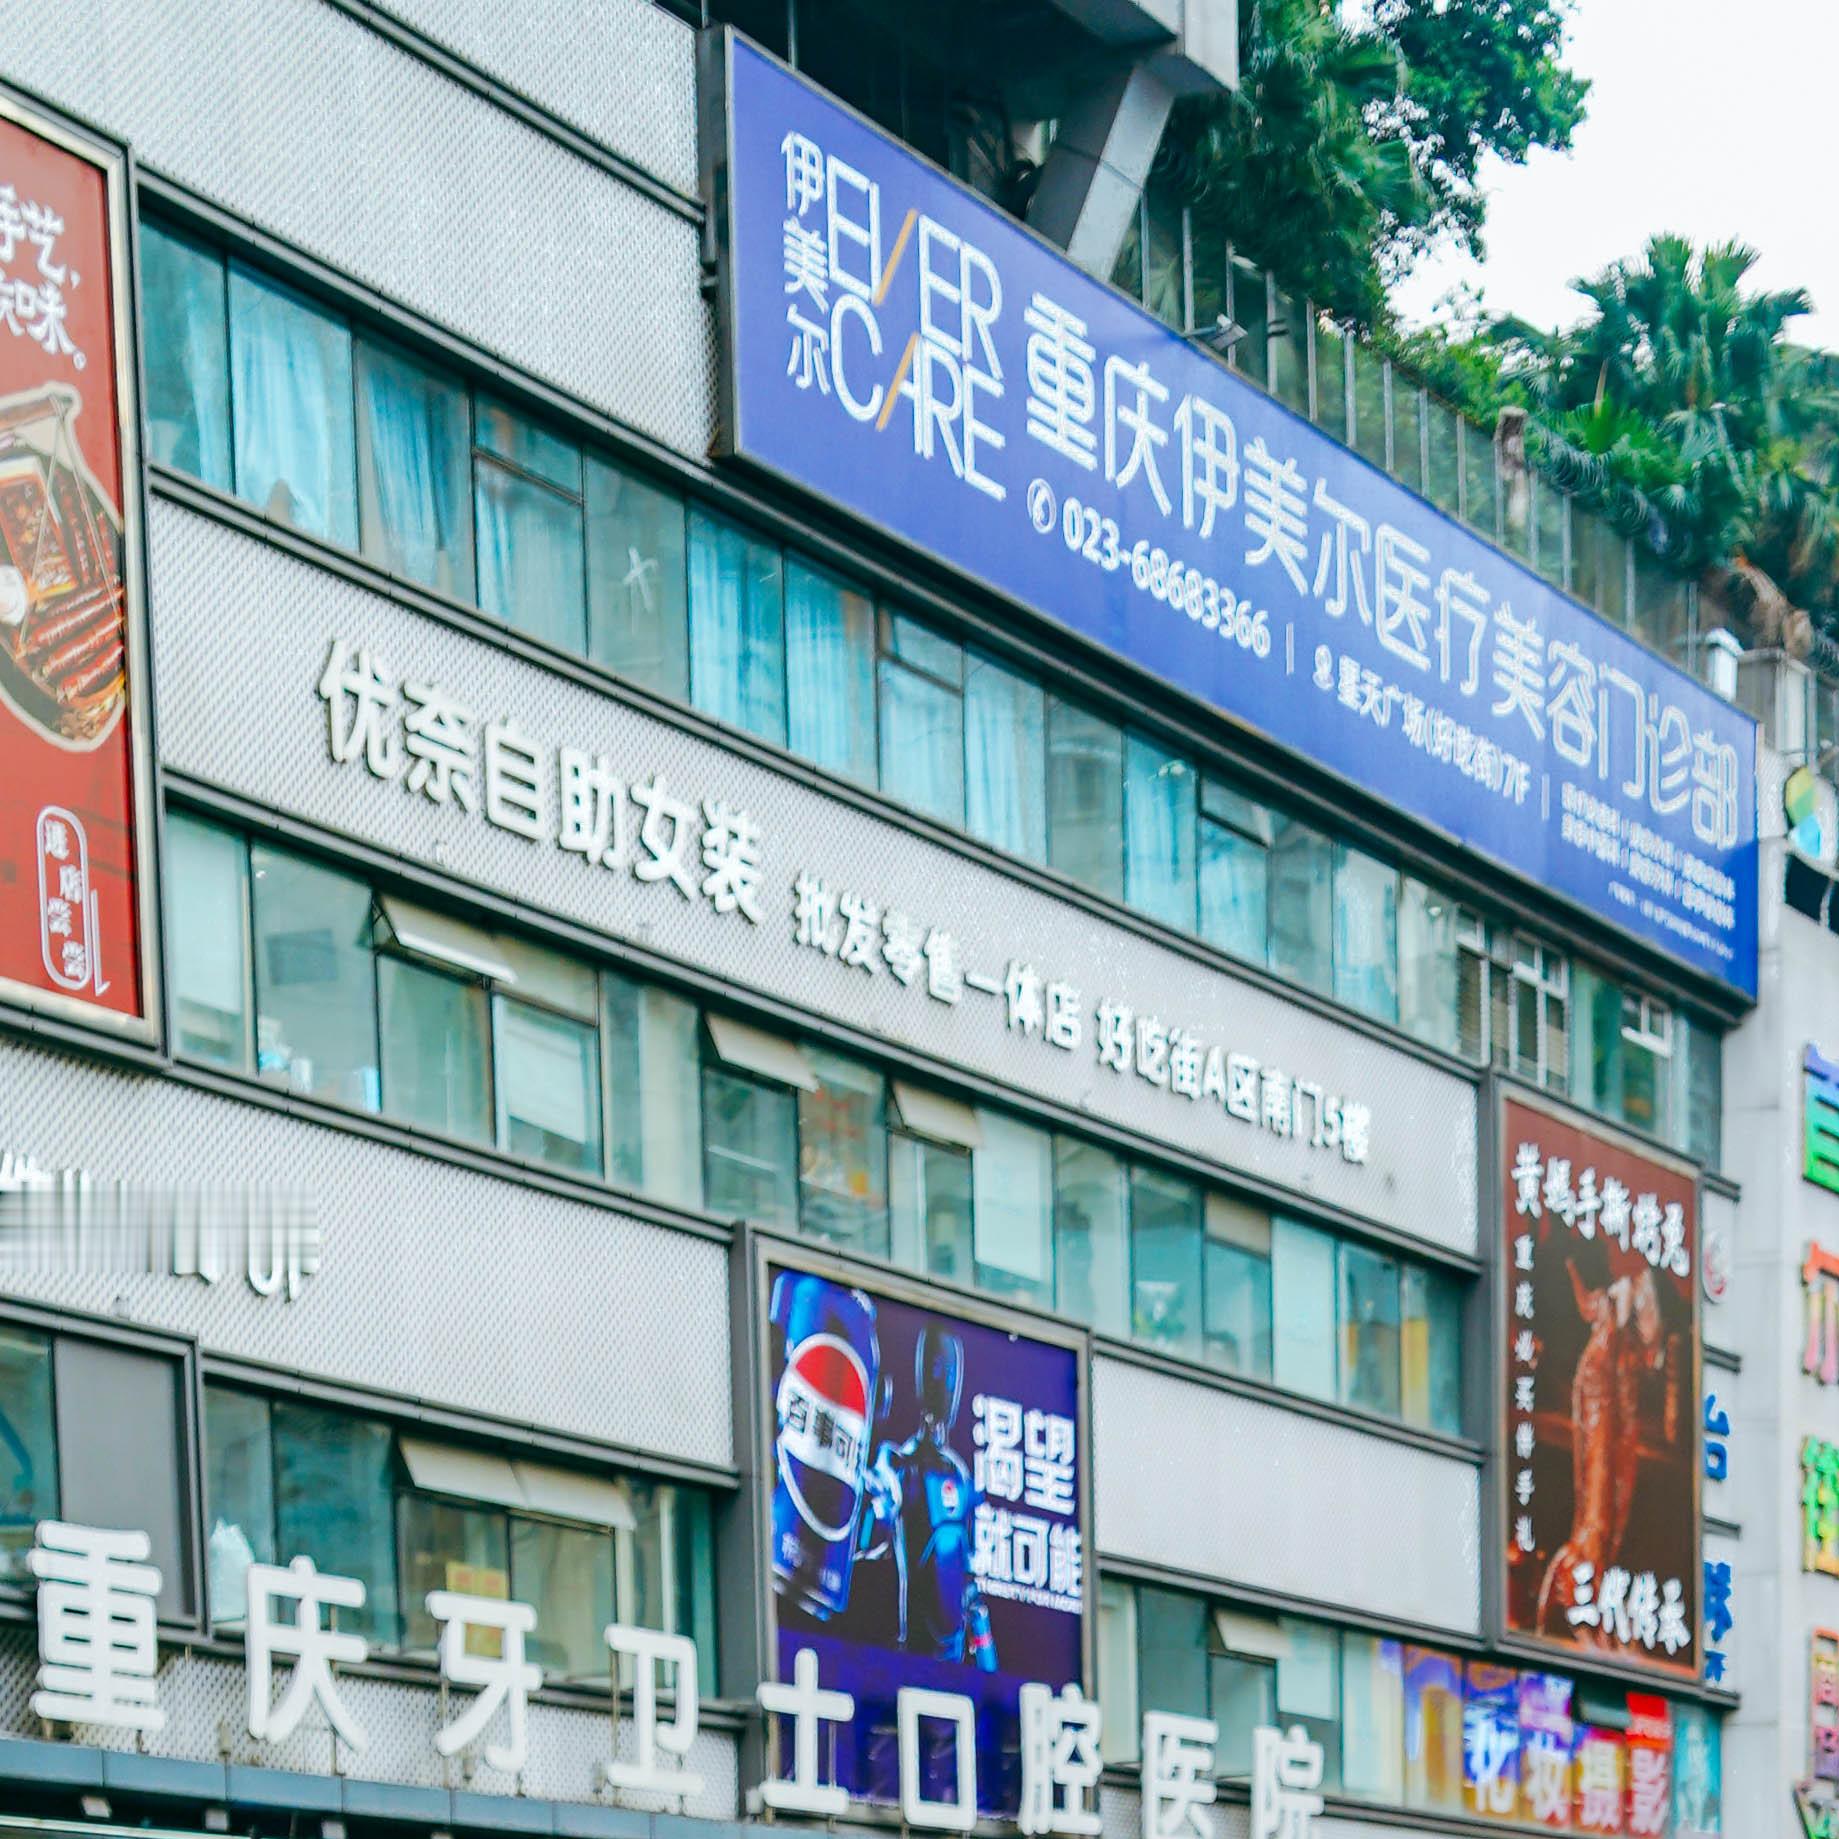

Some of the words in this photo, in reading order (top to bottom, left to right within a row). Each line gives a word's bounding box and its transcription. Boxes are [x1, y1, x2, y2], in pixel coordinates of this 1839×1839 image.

[780, 131, 829, 395] 伊美尔
[1024, 292, 1740, 850] 重庆伊美尔医疗美容门诊部
[1062, 498, 1271, 659] 023-68683366
[317, 637, 763, 924] 优奈自助女装
[793, 870, 1082, 1050] 批发零售一体店
[1097, 997, 1371, 1165] 好吃街A区南门5楼
[972, 1392, 1076, 1516] 渴望
[972, 1503, 1084, 1593] 就可能
